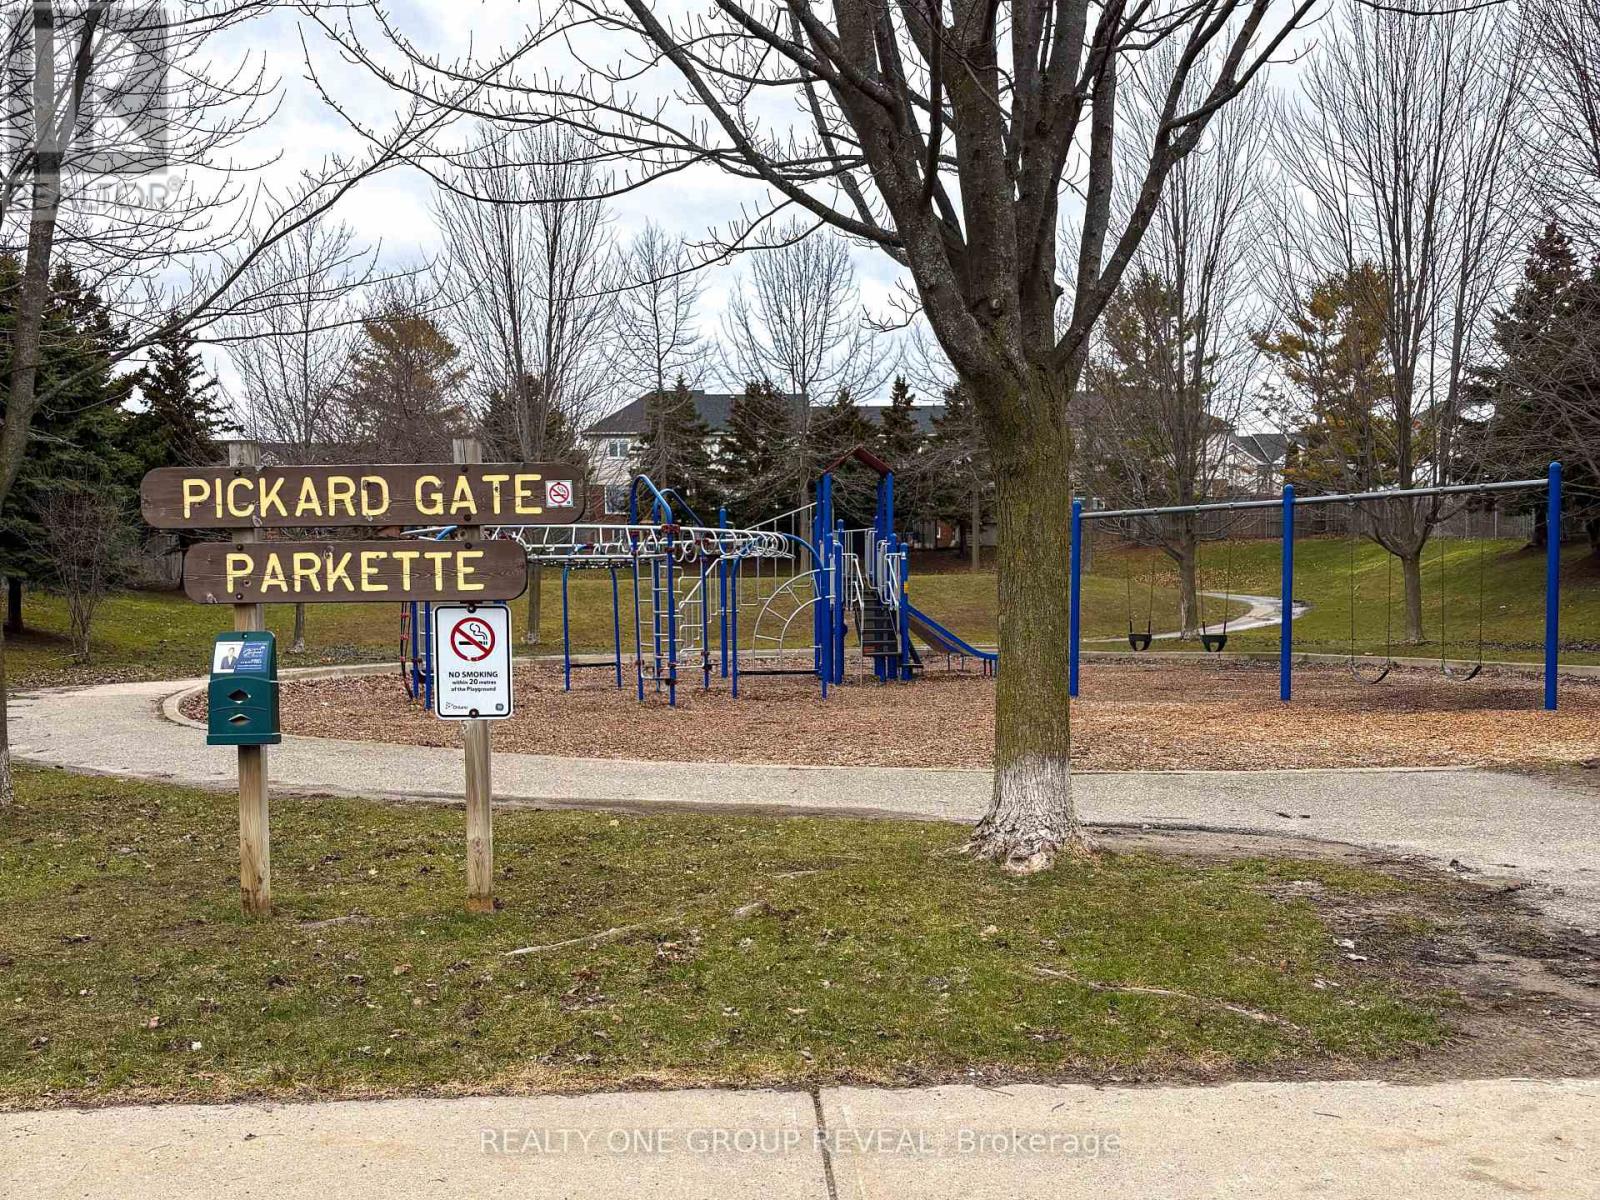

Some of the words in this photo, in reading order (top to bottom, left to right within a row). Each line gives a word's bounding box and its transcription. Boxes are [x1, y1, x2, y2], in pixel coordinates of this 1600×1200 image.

[183, 474, 391, 519] PICKARD
[415, 473, 543, 515] GATE
[226, 550, 486, 593] PARKETTE
